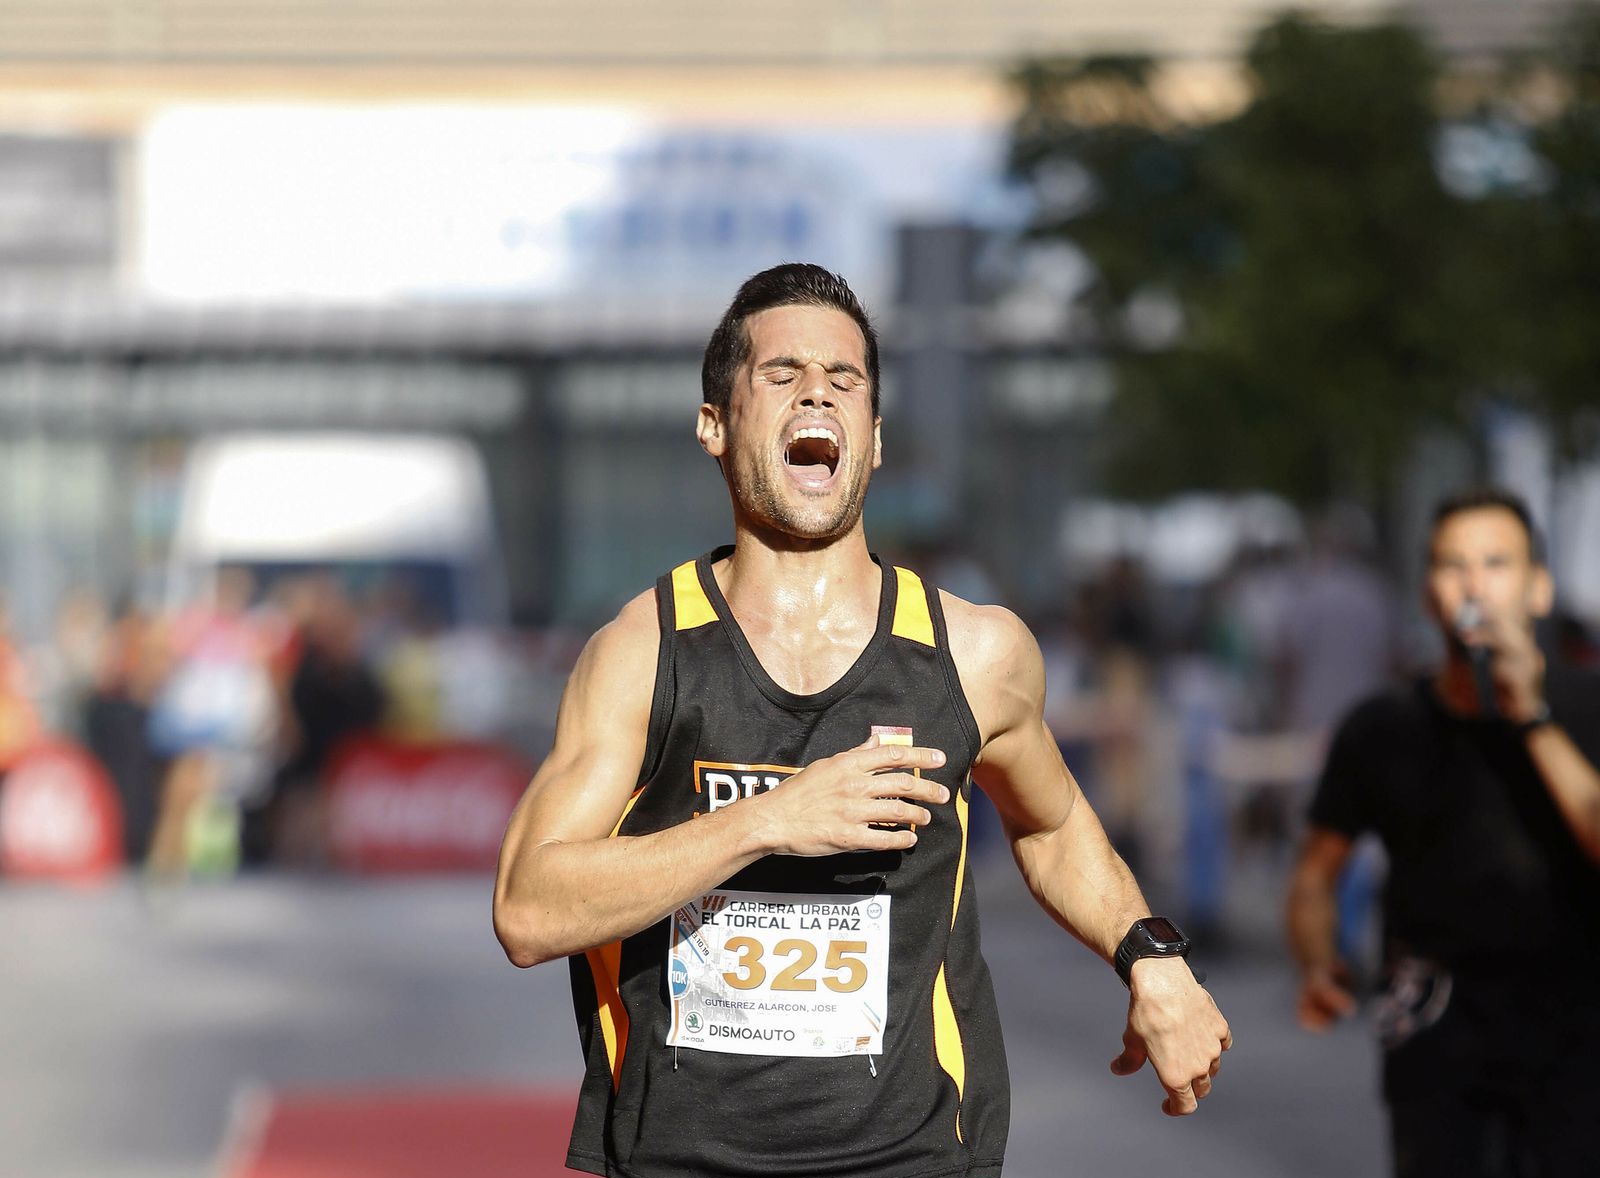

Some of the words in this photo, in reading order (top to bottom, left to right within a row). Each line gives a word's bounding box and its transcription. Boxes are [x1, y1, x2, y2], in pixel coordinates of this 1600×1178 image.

[730, 901, 796, 914] CARRERA
[801, 904, 860, 916] URBANA
[701, 912, 719, 926] EL
[725, 914, 791, 930] TORCAL
[800, 916, 821, 930] LA
[828, 917, 861, 931] PAZ
[722, 936, 868, 993] 325
[705, 999, 755, 1011] GUTIERREZ
[757, 1001, 809, 1012] ALARCON,
[811, 1004, 837, 1013] JOSE
[709, 1024, 795, 1042] DISMOAUTO
